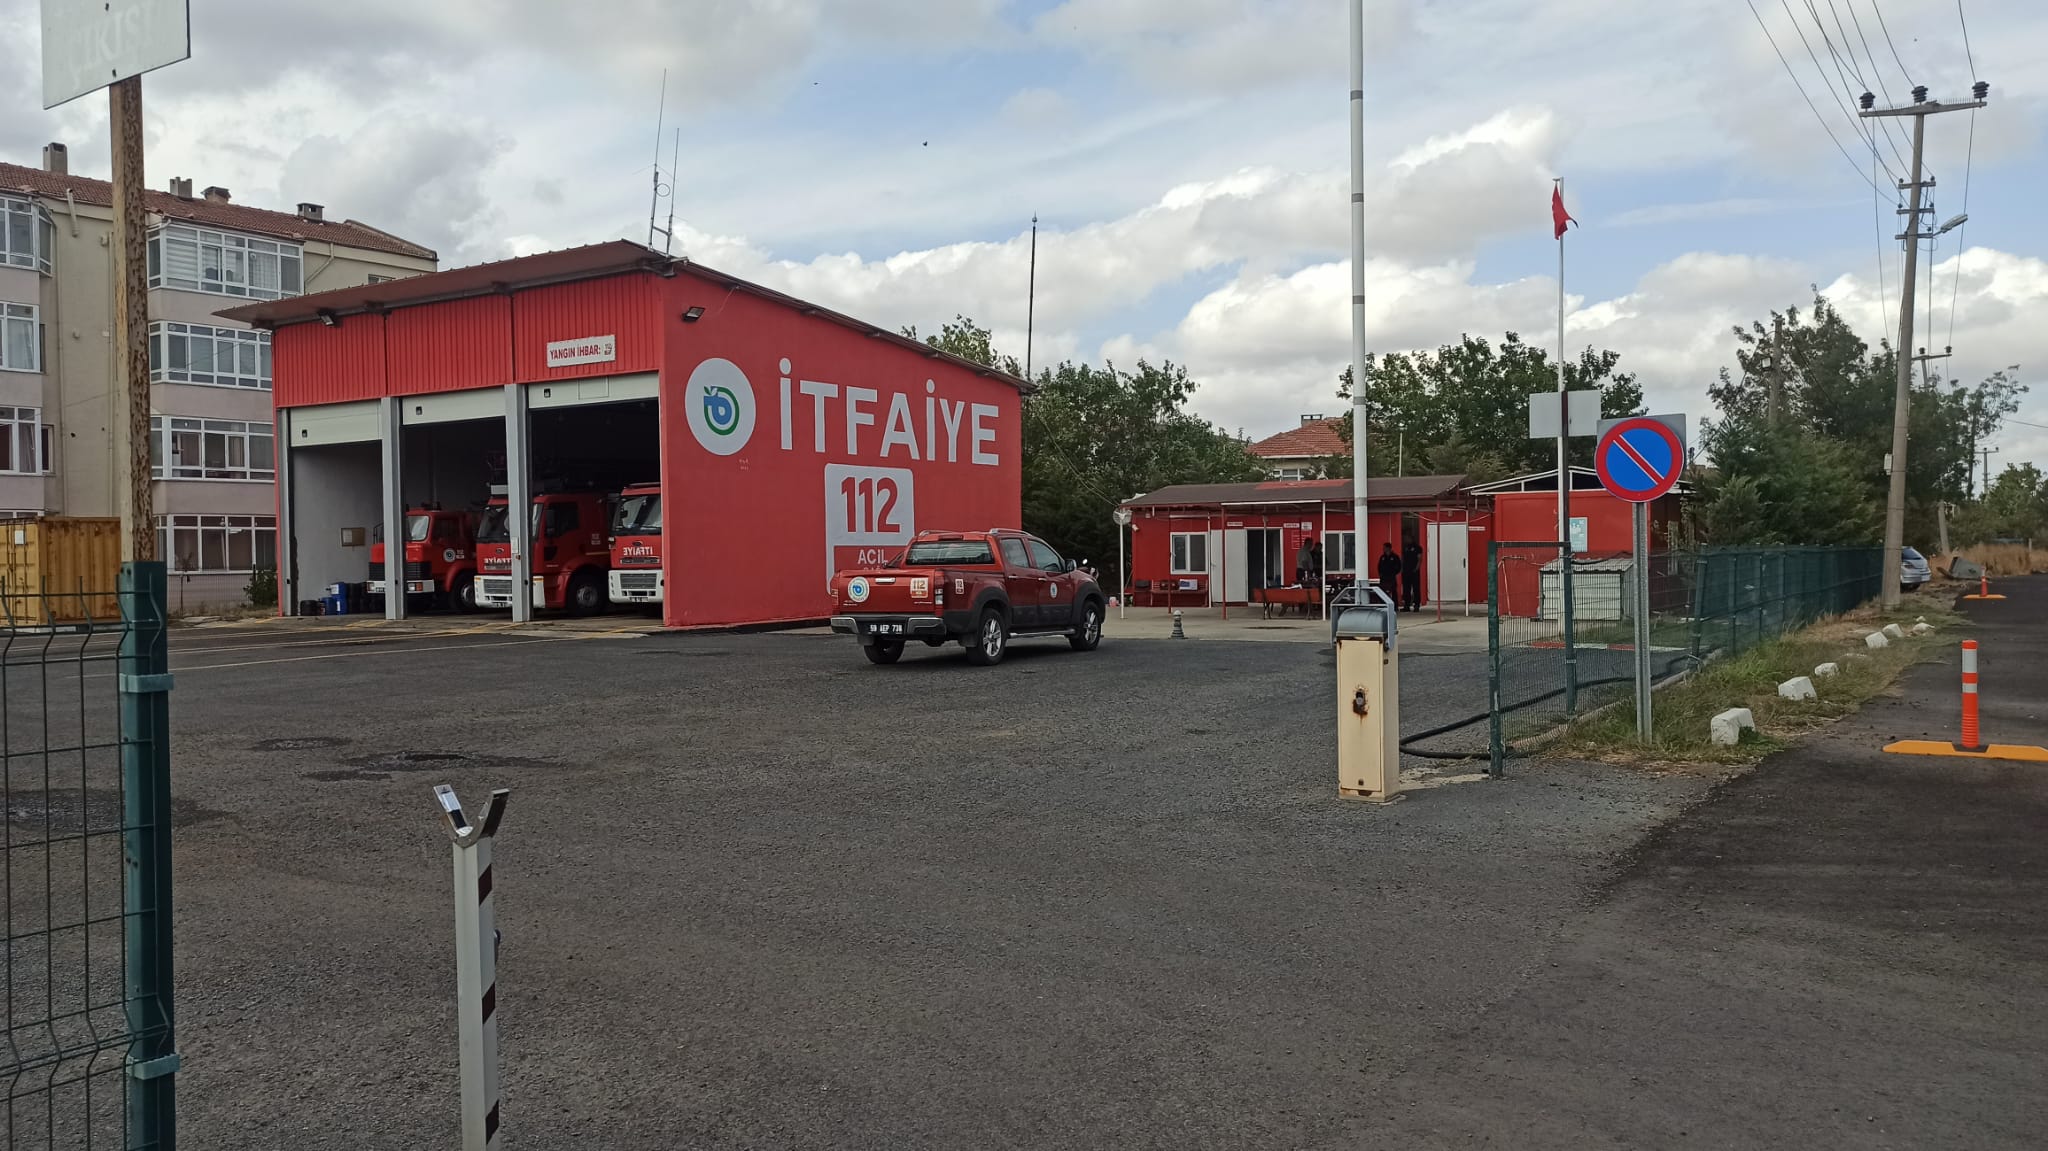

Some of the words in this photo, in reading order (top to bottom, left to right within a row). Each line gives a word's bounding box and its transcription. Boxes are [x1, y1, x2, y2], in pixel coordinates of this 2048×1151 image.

[779, 357, 999, 466] İTFAİYE
[841, 476, 901, 533] 112
[857, 548, 889, 565] ACİL
[912, 580, 926, 590] 112
